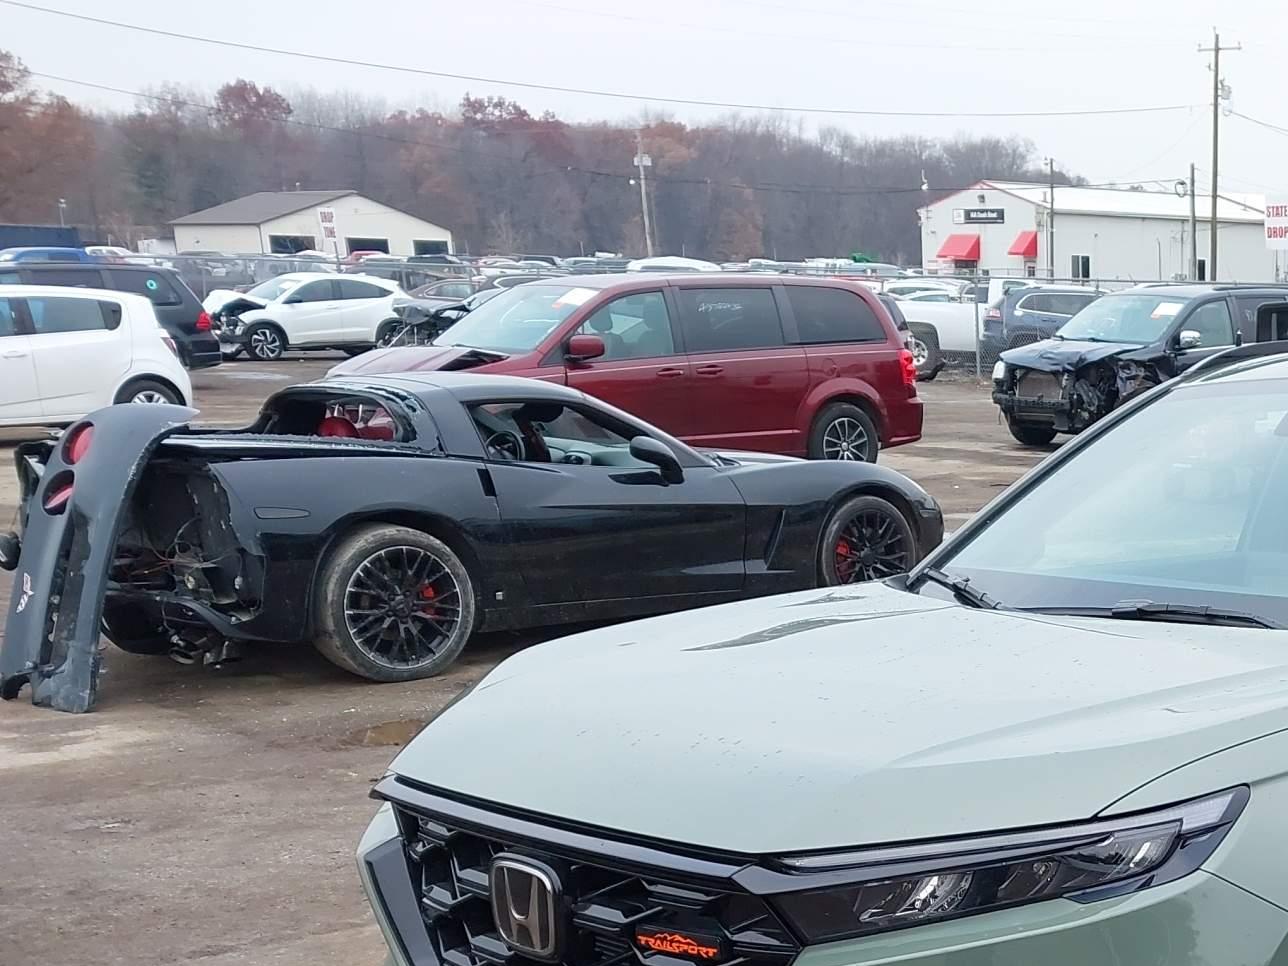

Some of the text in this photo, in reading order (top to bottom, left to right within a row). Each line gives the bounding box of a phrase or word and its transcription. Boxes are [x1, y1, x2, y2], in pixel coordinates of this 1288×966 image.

[1266, 205, 1288, 218] STATE
[1267, 226, 1288, 239] DROP
[637, 935, 718, 958] TRAILSPORT
